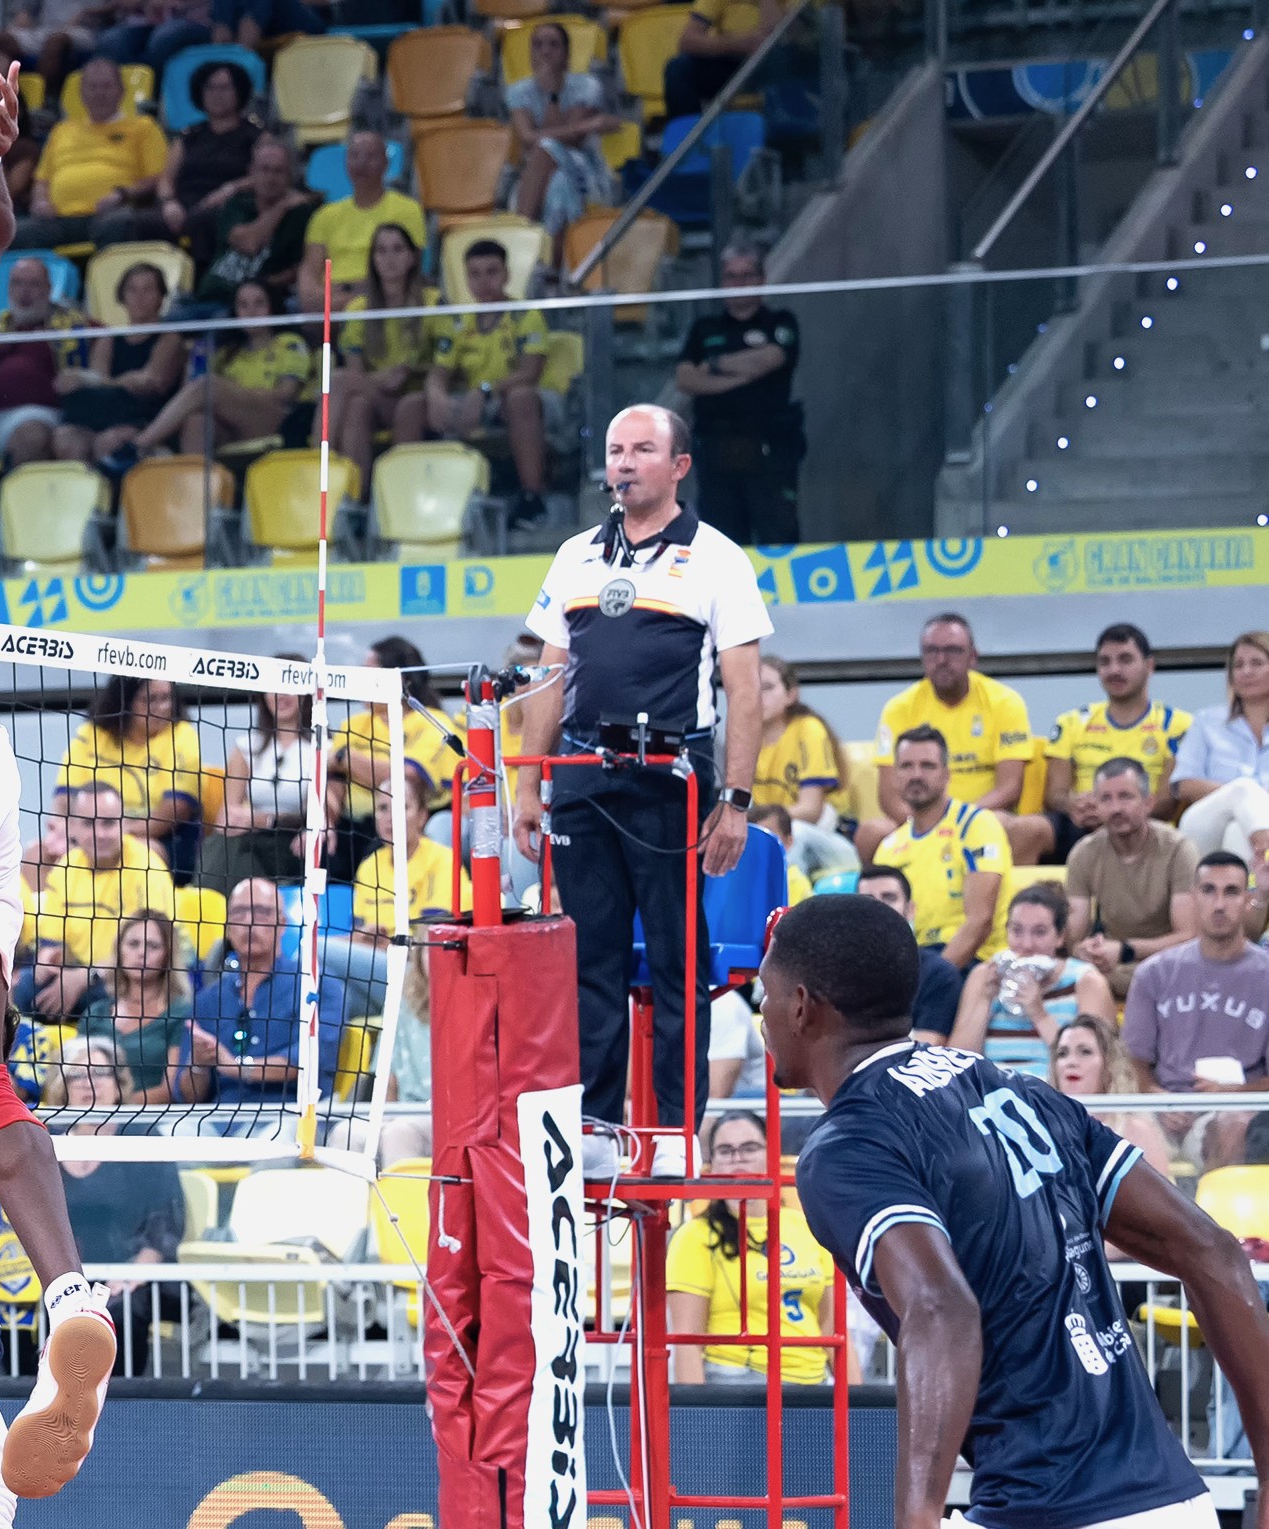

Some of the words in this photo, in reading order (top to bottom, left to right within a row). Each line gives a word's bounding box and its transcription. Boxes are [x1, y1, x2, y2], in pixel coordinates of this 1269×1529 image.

[1, 634, 74, 660] ACERBIS
[98, 646, 167, 671] rfevb.com
[192, 657, 260, 680] ACERBIS
[968, 1087, 1063, 1199] 20
